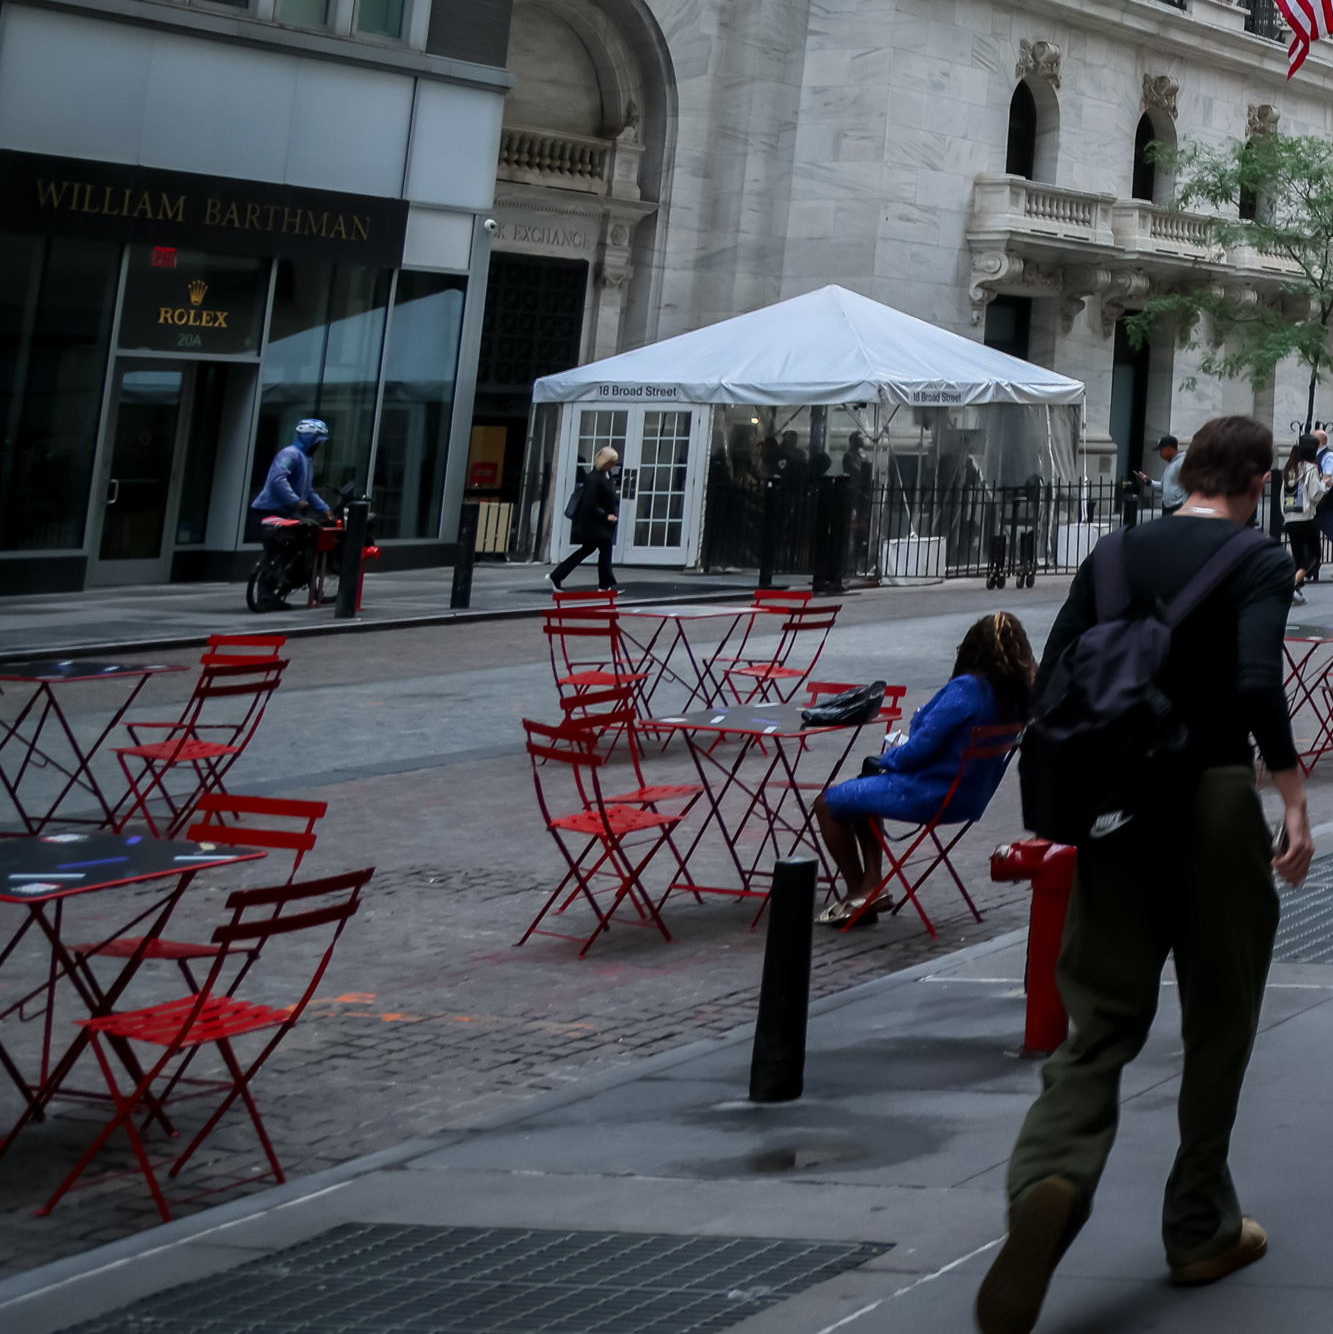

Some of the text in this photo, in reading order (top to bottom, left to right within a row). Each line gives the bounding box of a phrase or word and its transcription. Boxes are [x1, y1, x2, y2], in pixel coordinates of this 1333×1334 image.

[35, 177, 372, 243] WILLIAM BARTHMAN
[513, 223, 592, 250] EXCHANGE
[158, 307, 229, 328] ROLEX
[177, 333, 202, 346] 20A
[598, 385, 677, 398] 18 Broad Street
[912, 391, 962, 404] 18 Broad Street
